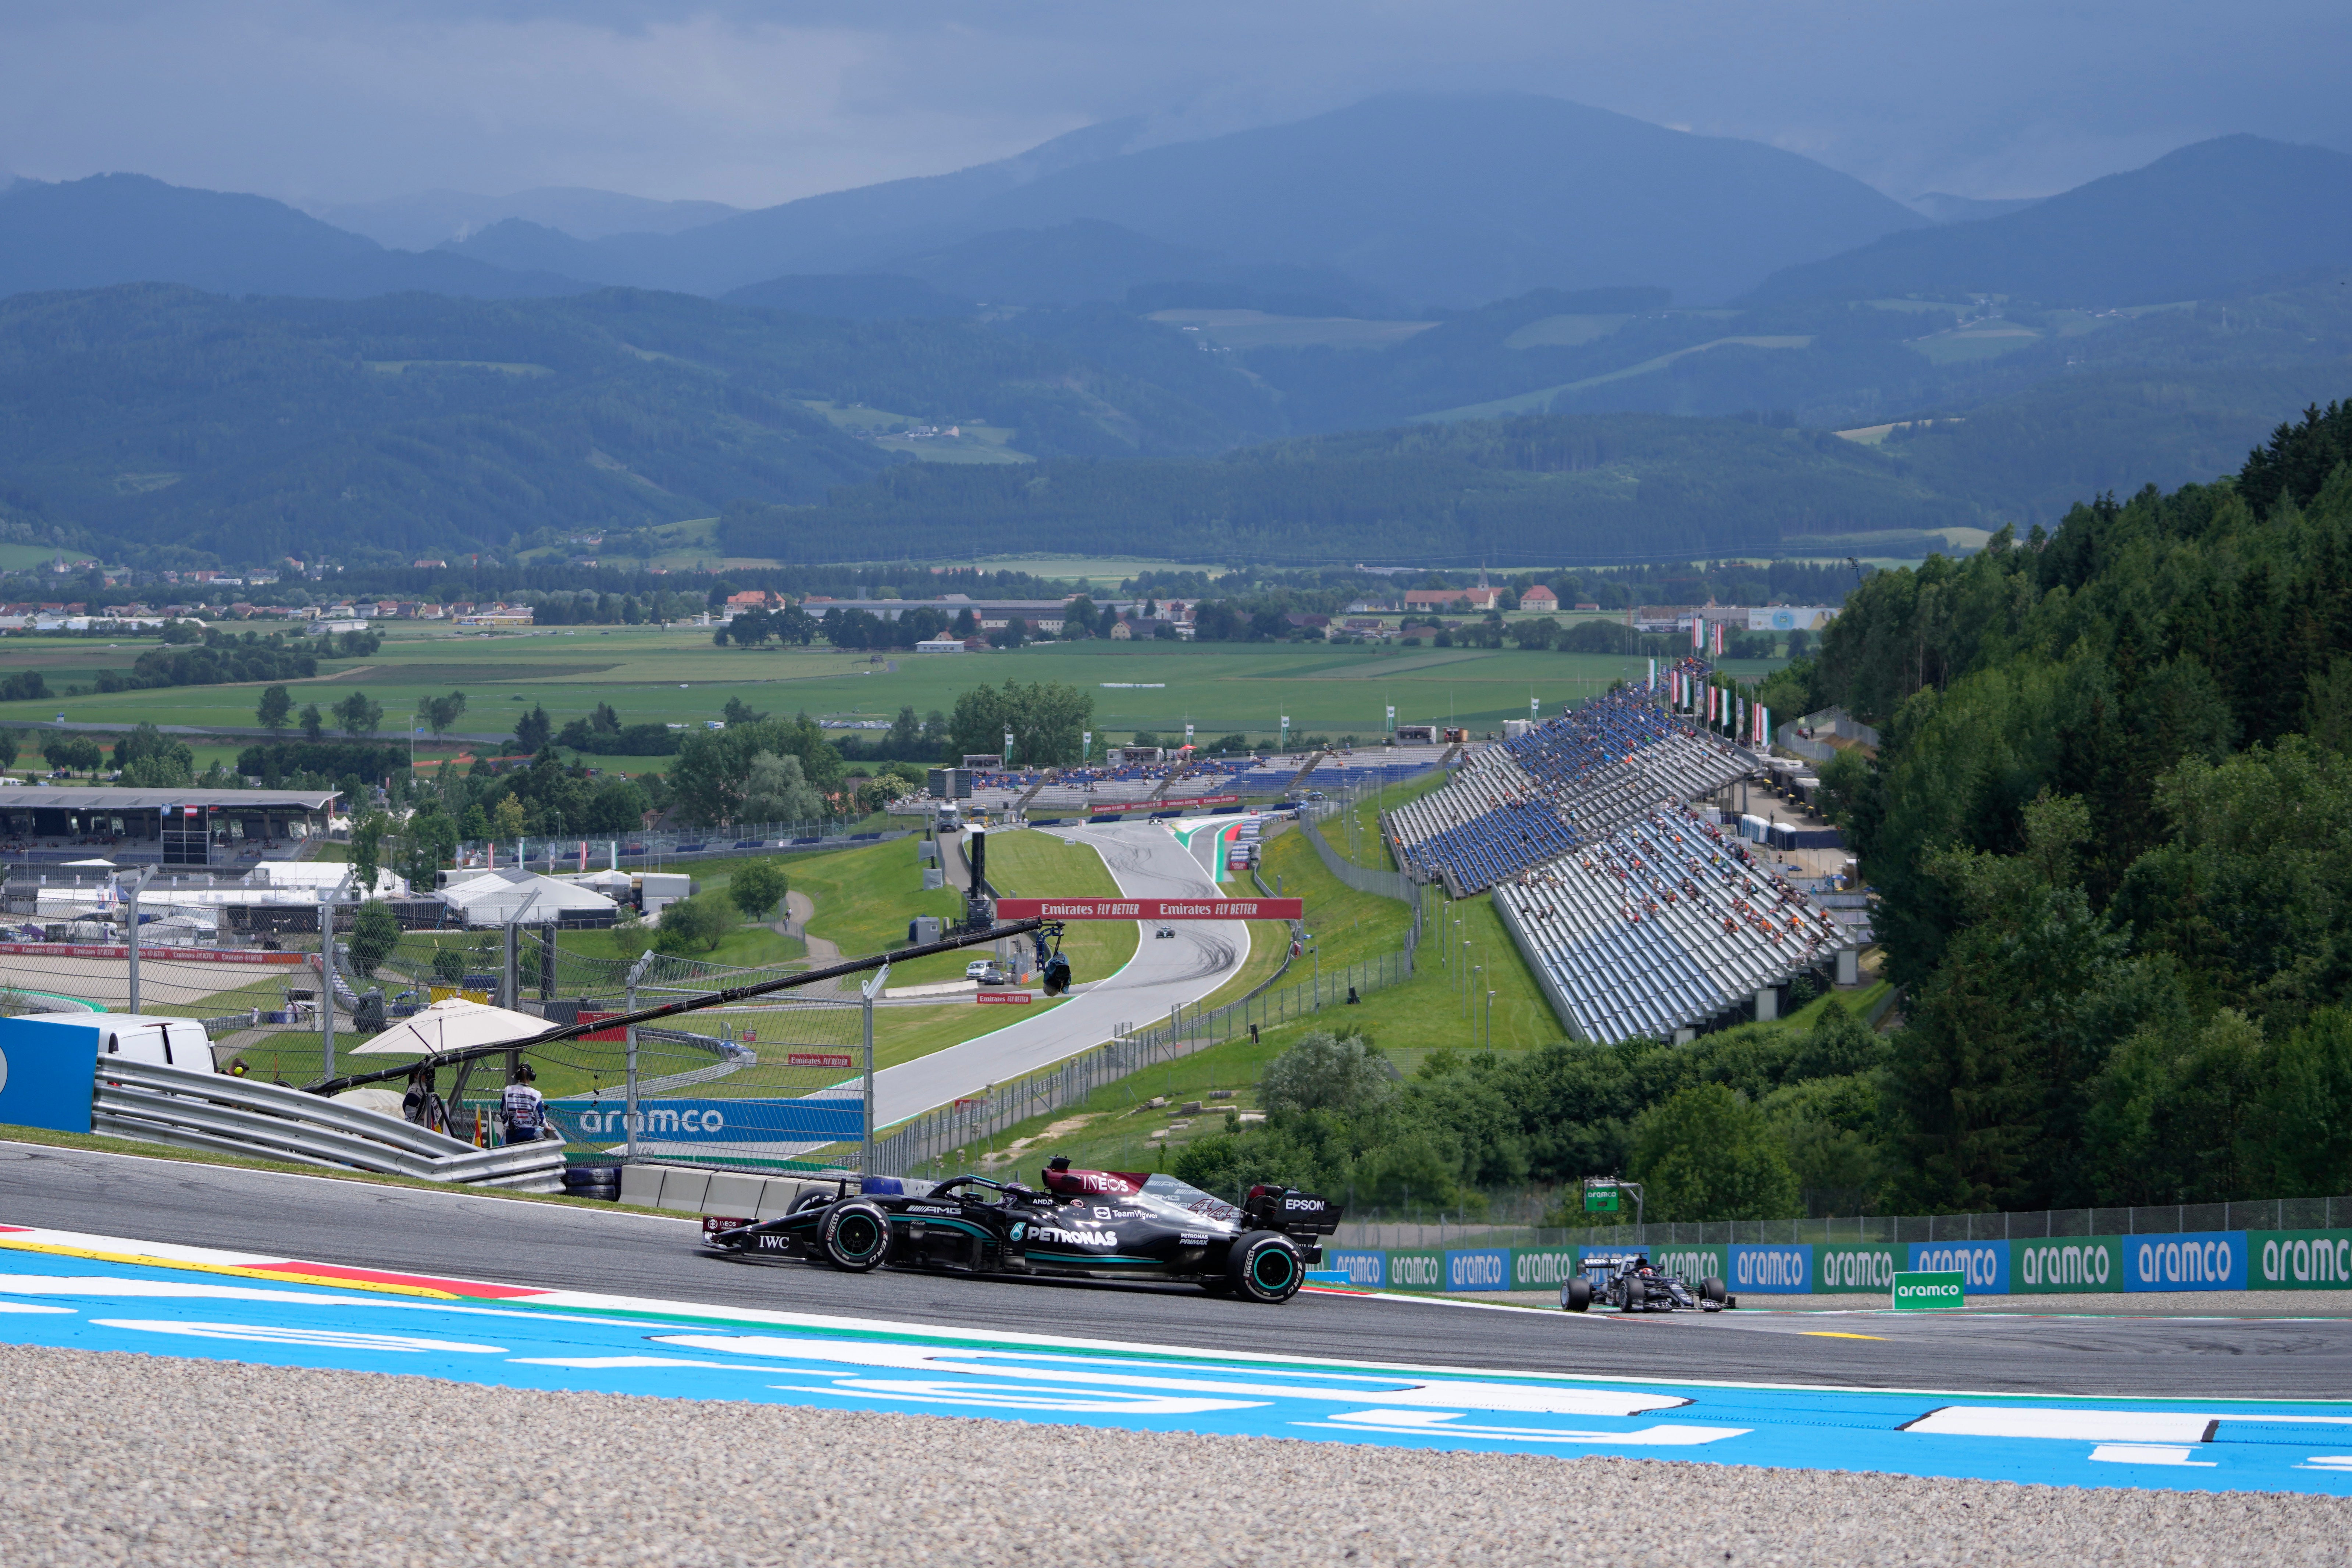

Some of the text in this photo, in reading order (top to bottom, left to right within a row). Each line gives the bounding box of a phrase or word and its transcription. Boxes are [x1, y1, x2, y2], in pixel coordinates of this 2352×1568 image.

[1041, 904, 1139, 915] Emirates FLY BETTER
[1160, 903, 1257, 915] Emirates FLY BETTER
[173, 951, 195, 959] Emirates
[580, 1109, 723, 1132] aramco
[1083, 1176, 1129, 1192] INEOS
[924, 1206, 961, 1215] AMG
[1112, 1209, 1158, 1219] TeamViewer
[1188, 1198, 1233, 1221] 44
[1285, 1199, 1325, 1211] EPSON
[826, 1213, 840, 1241] PIRELLI
[1027, 1226, 1118, 1246] PETRONAS
[759, 1235, 790, 1249] IWC
[869, 1230, 888, 1264] ZERO
[1243, 1249, 1255, 1277] PIRELLI
[1337, 1255, 1379, 1283] aramco
[1392, 1256, 1438, 1284] aramco
[1453, 1255, 1501, 1284] aramco
[1517, 1253, 1570, 1283] aramco
[1659, 1252, 1718, 1283] aramco
[1738, 1251, 1803, 1286] aramco
[1823, 1251, 1892, 1287] aramco
[1919, 1248, 1996, 1286] aramco
[2023, 1245, 2110, 1284] aramco
[2139, 1241, 2231, 1282] aramco
[2262, 1239, 2352, 1282] aramc
[1287, 1261, 1303, 1295] ZERO
[1897, 1283, 1959, 1297] aramco
